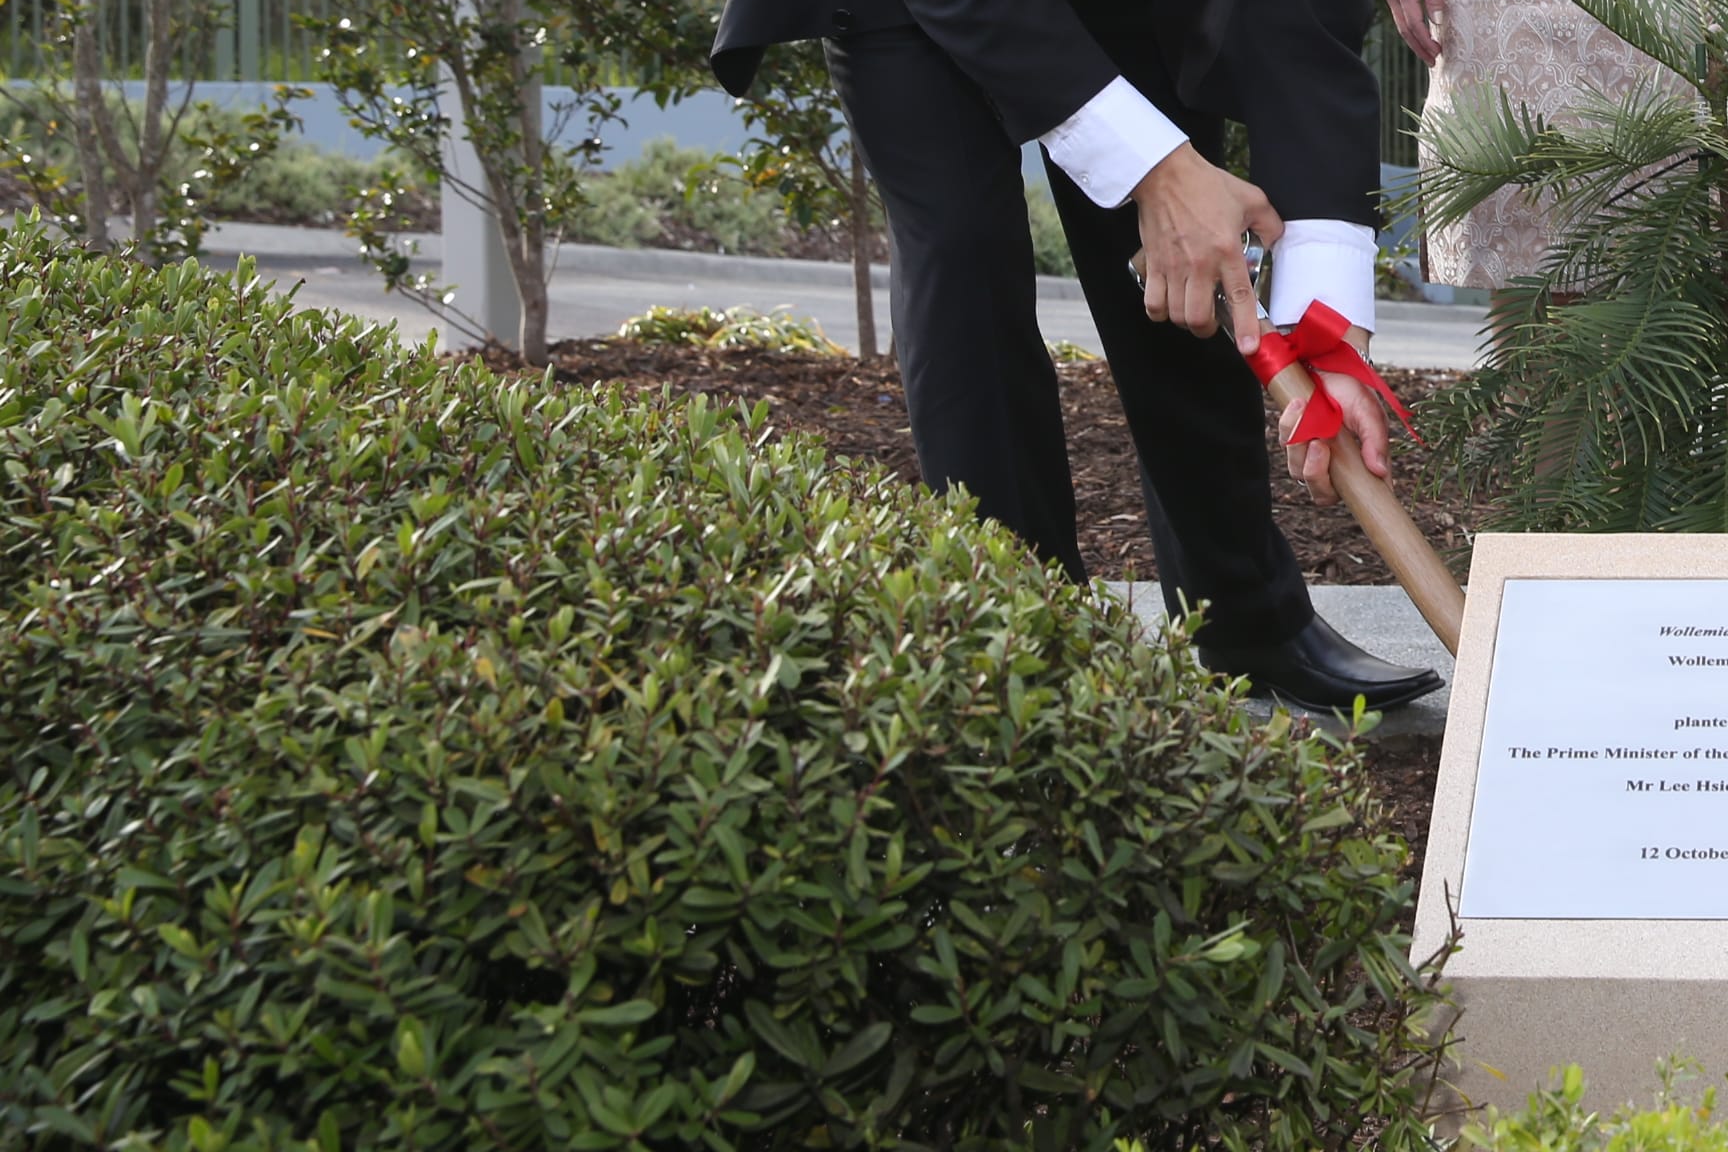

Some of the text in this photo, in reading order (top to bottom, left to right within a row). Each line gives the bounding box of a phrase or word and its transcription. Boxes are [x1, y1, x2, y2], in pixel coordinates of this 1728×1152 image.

[1506, 747, 1543, 759] The
[1545, 747, 1600, 759] Prime
[1603, 747, 1680, 760] Minister
[1682, 747, 1703, 760] of
[1624, 779, 1656, 792] Mr
[1658, 779, 1692, 792] Lee
[1640, 846, 1661, 860] 12
